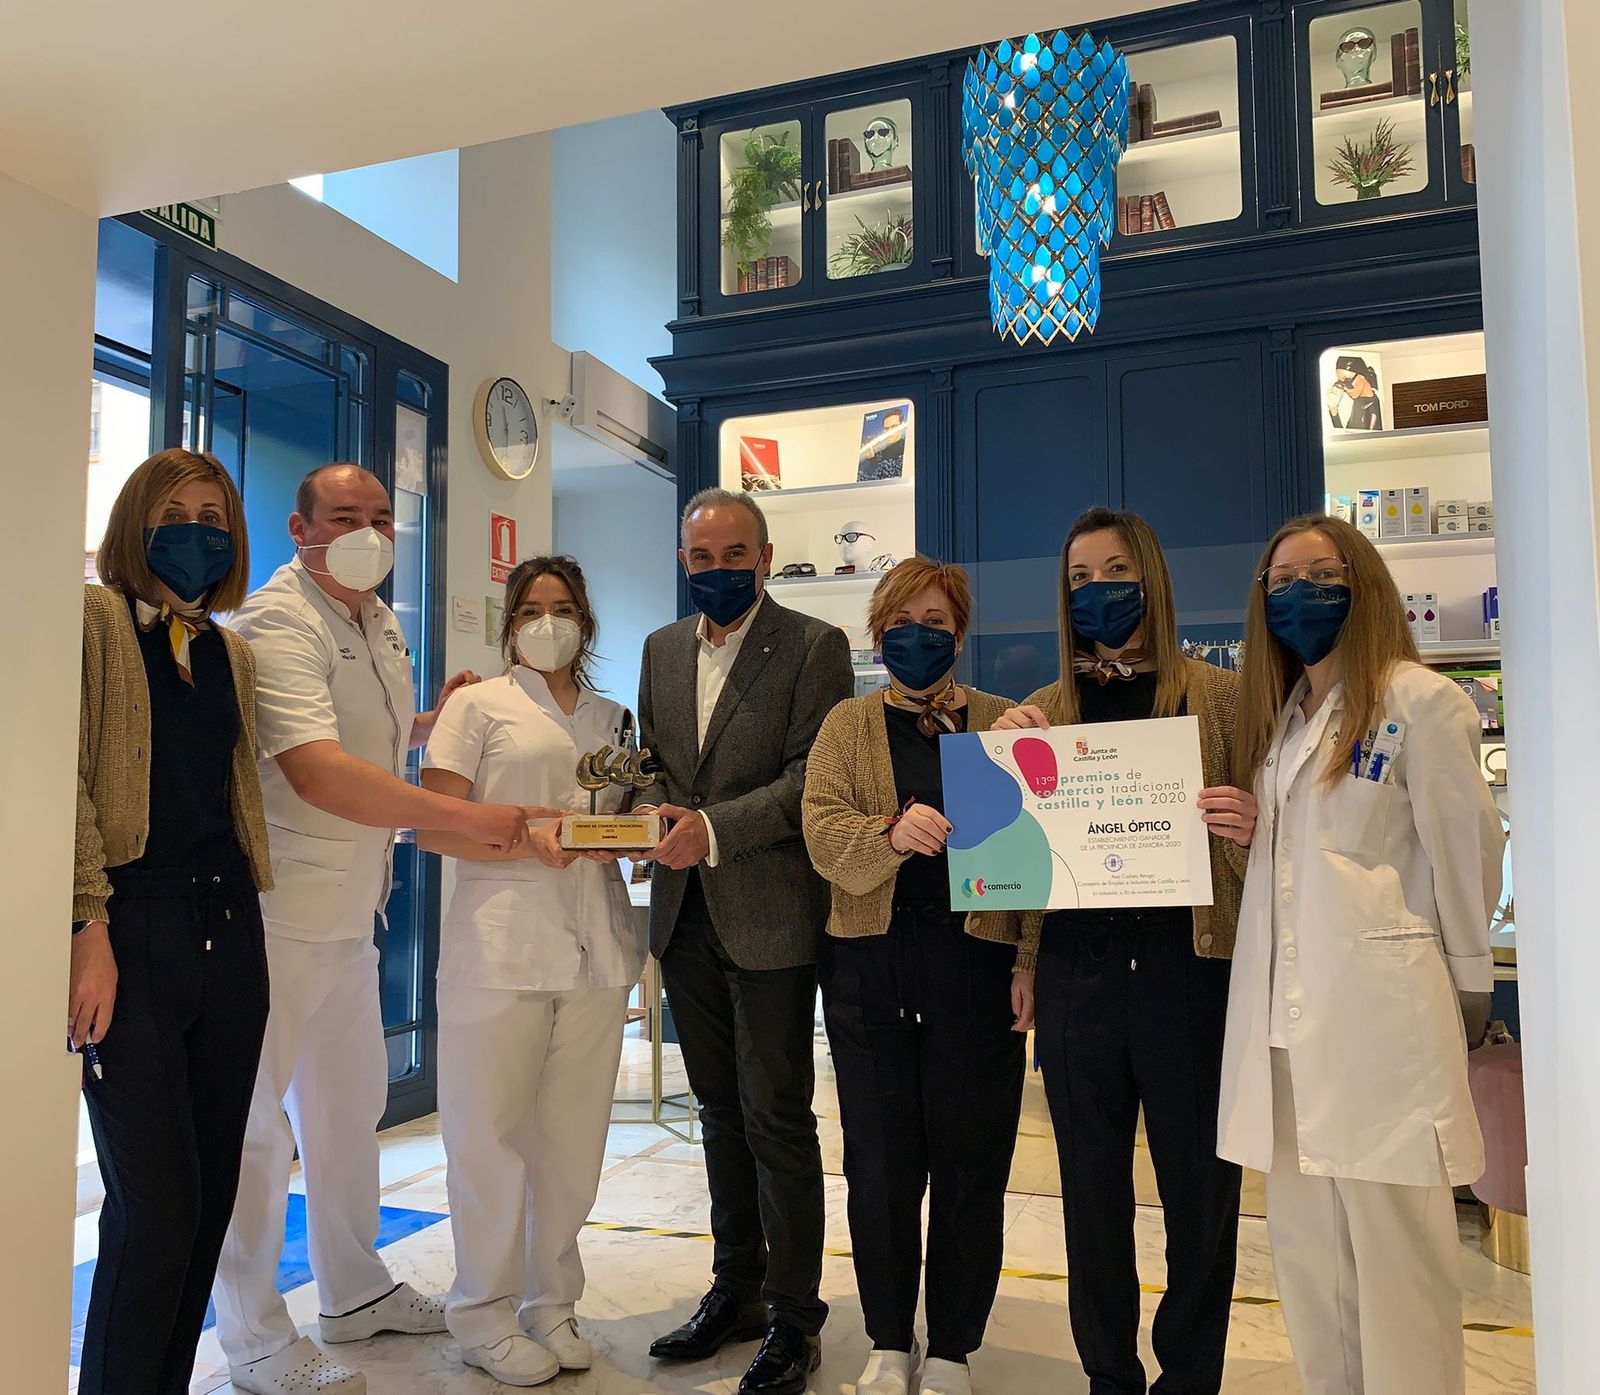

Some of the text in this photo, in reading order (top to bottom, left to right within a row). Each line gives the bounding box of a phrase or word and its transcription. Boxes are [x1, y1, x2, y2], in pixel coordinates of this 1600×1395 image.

[150, 204, 211, 242] ALIDA
[501, 385, 513, 406] 12
[1414, 400, 1469, 413] TOM FORD
[520, 430, 528, 446] 3
[1073, 754, 1096, 762] Castilla
[1060, 771, 1120, 786] premios
[1126, 769, 1142, 780] de
[1035, 778, 1184, 798] comercio tradicional
[1037, 791, 1187, 810] castilla y león 2020
[1087, 819, 1172, 834] ÁNGEL ÓPTICO
[1088, 835, 1139, 843] ESTABLECIMIENTO
